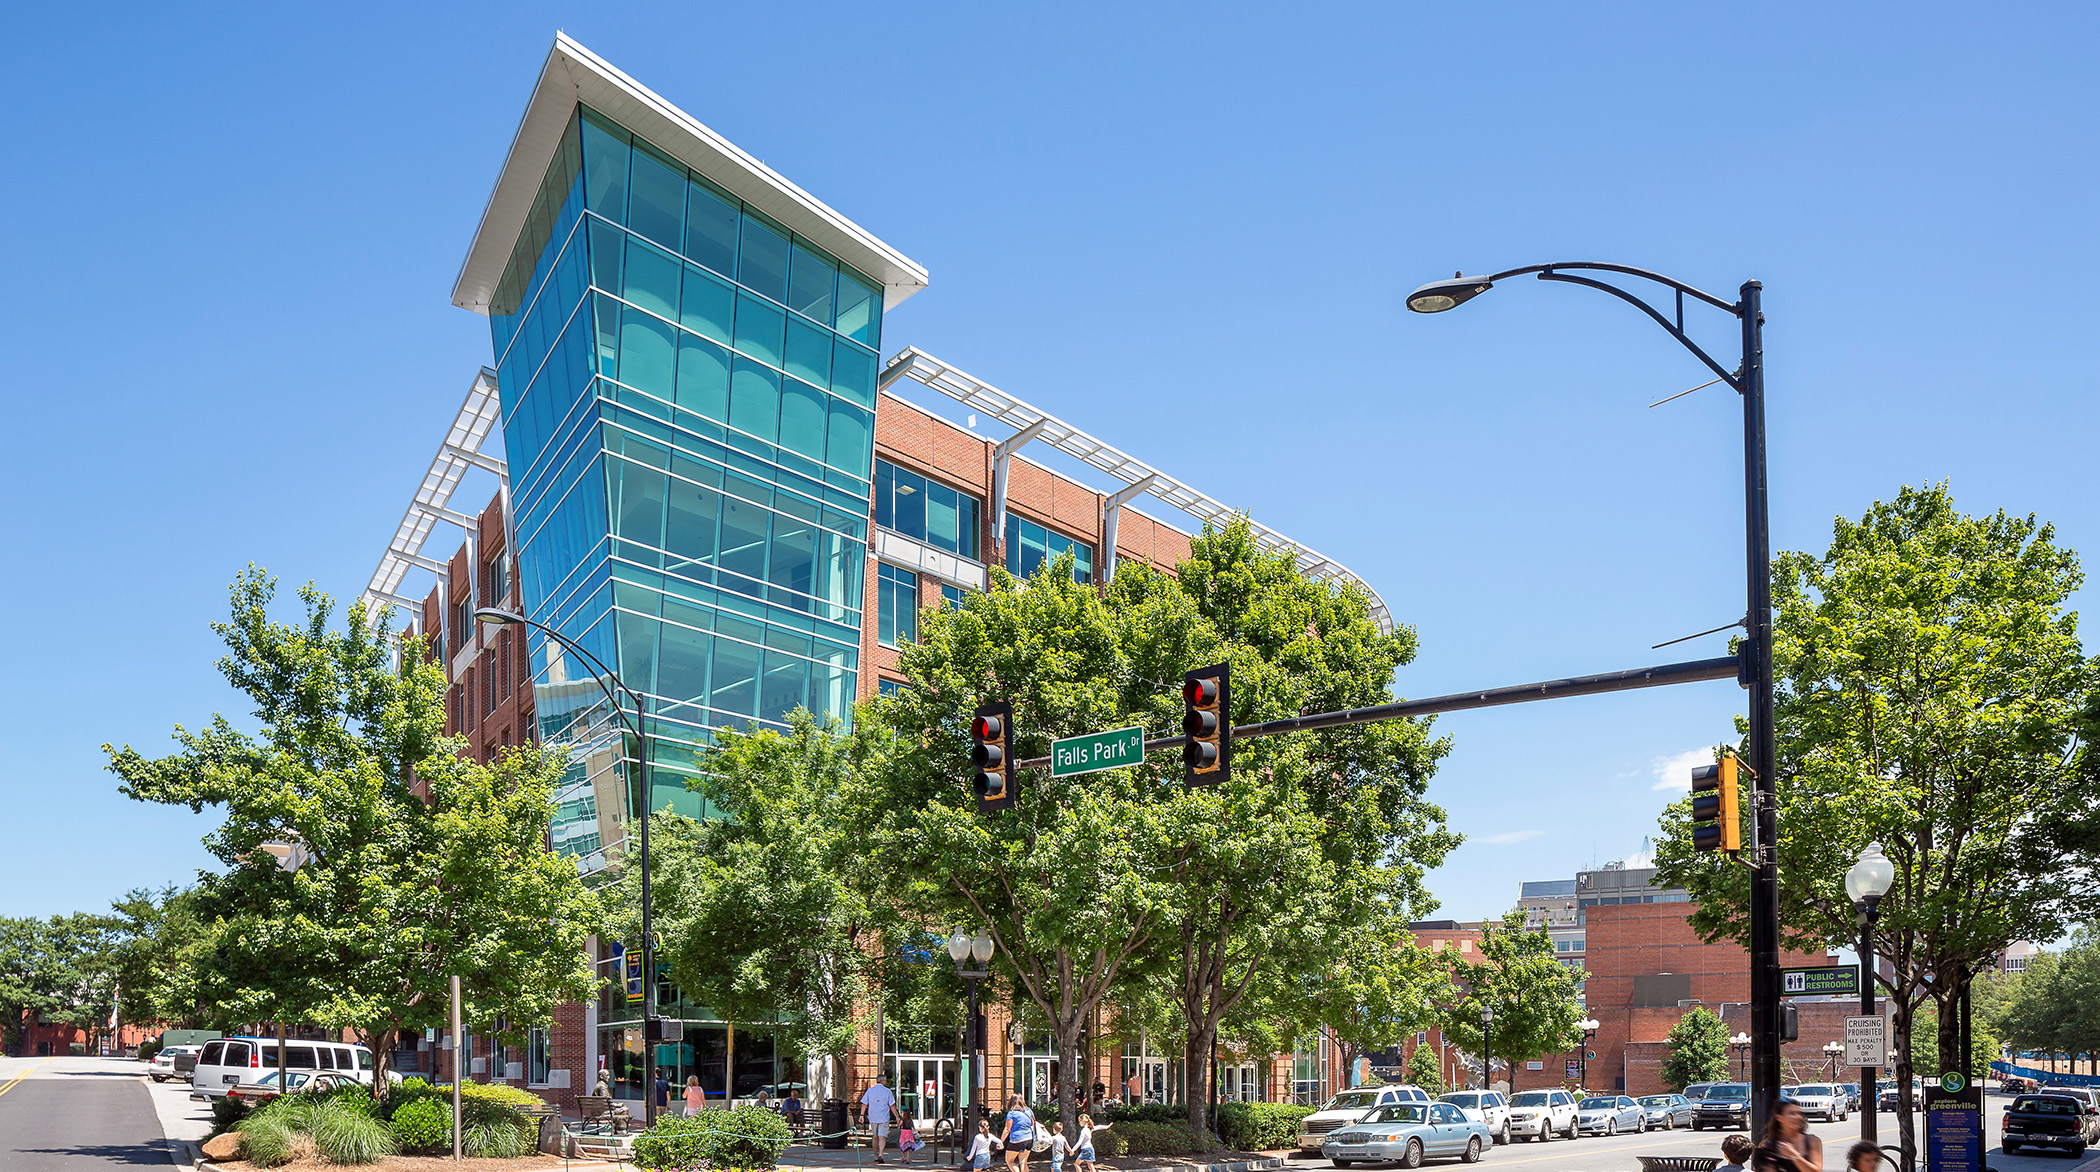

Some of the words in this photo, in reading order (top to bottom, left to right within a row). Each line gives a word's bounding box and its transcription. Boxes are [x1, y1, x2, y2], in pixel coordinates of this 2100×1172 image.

[1057, 746, 1088, 767] Falls
[1094, 739, 1126, 761] Park
[1131, 736, 1140, 746] Dr
[1806, 973, 1835, 982] PUBLIC
[1806, 980, 1854, 990] RESTROOMS
[1848, 1028, 1882, 1036] PROHIBITED
[1930, 1102, 1977, 1110] greenville
